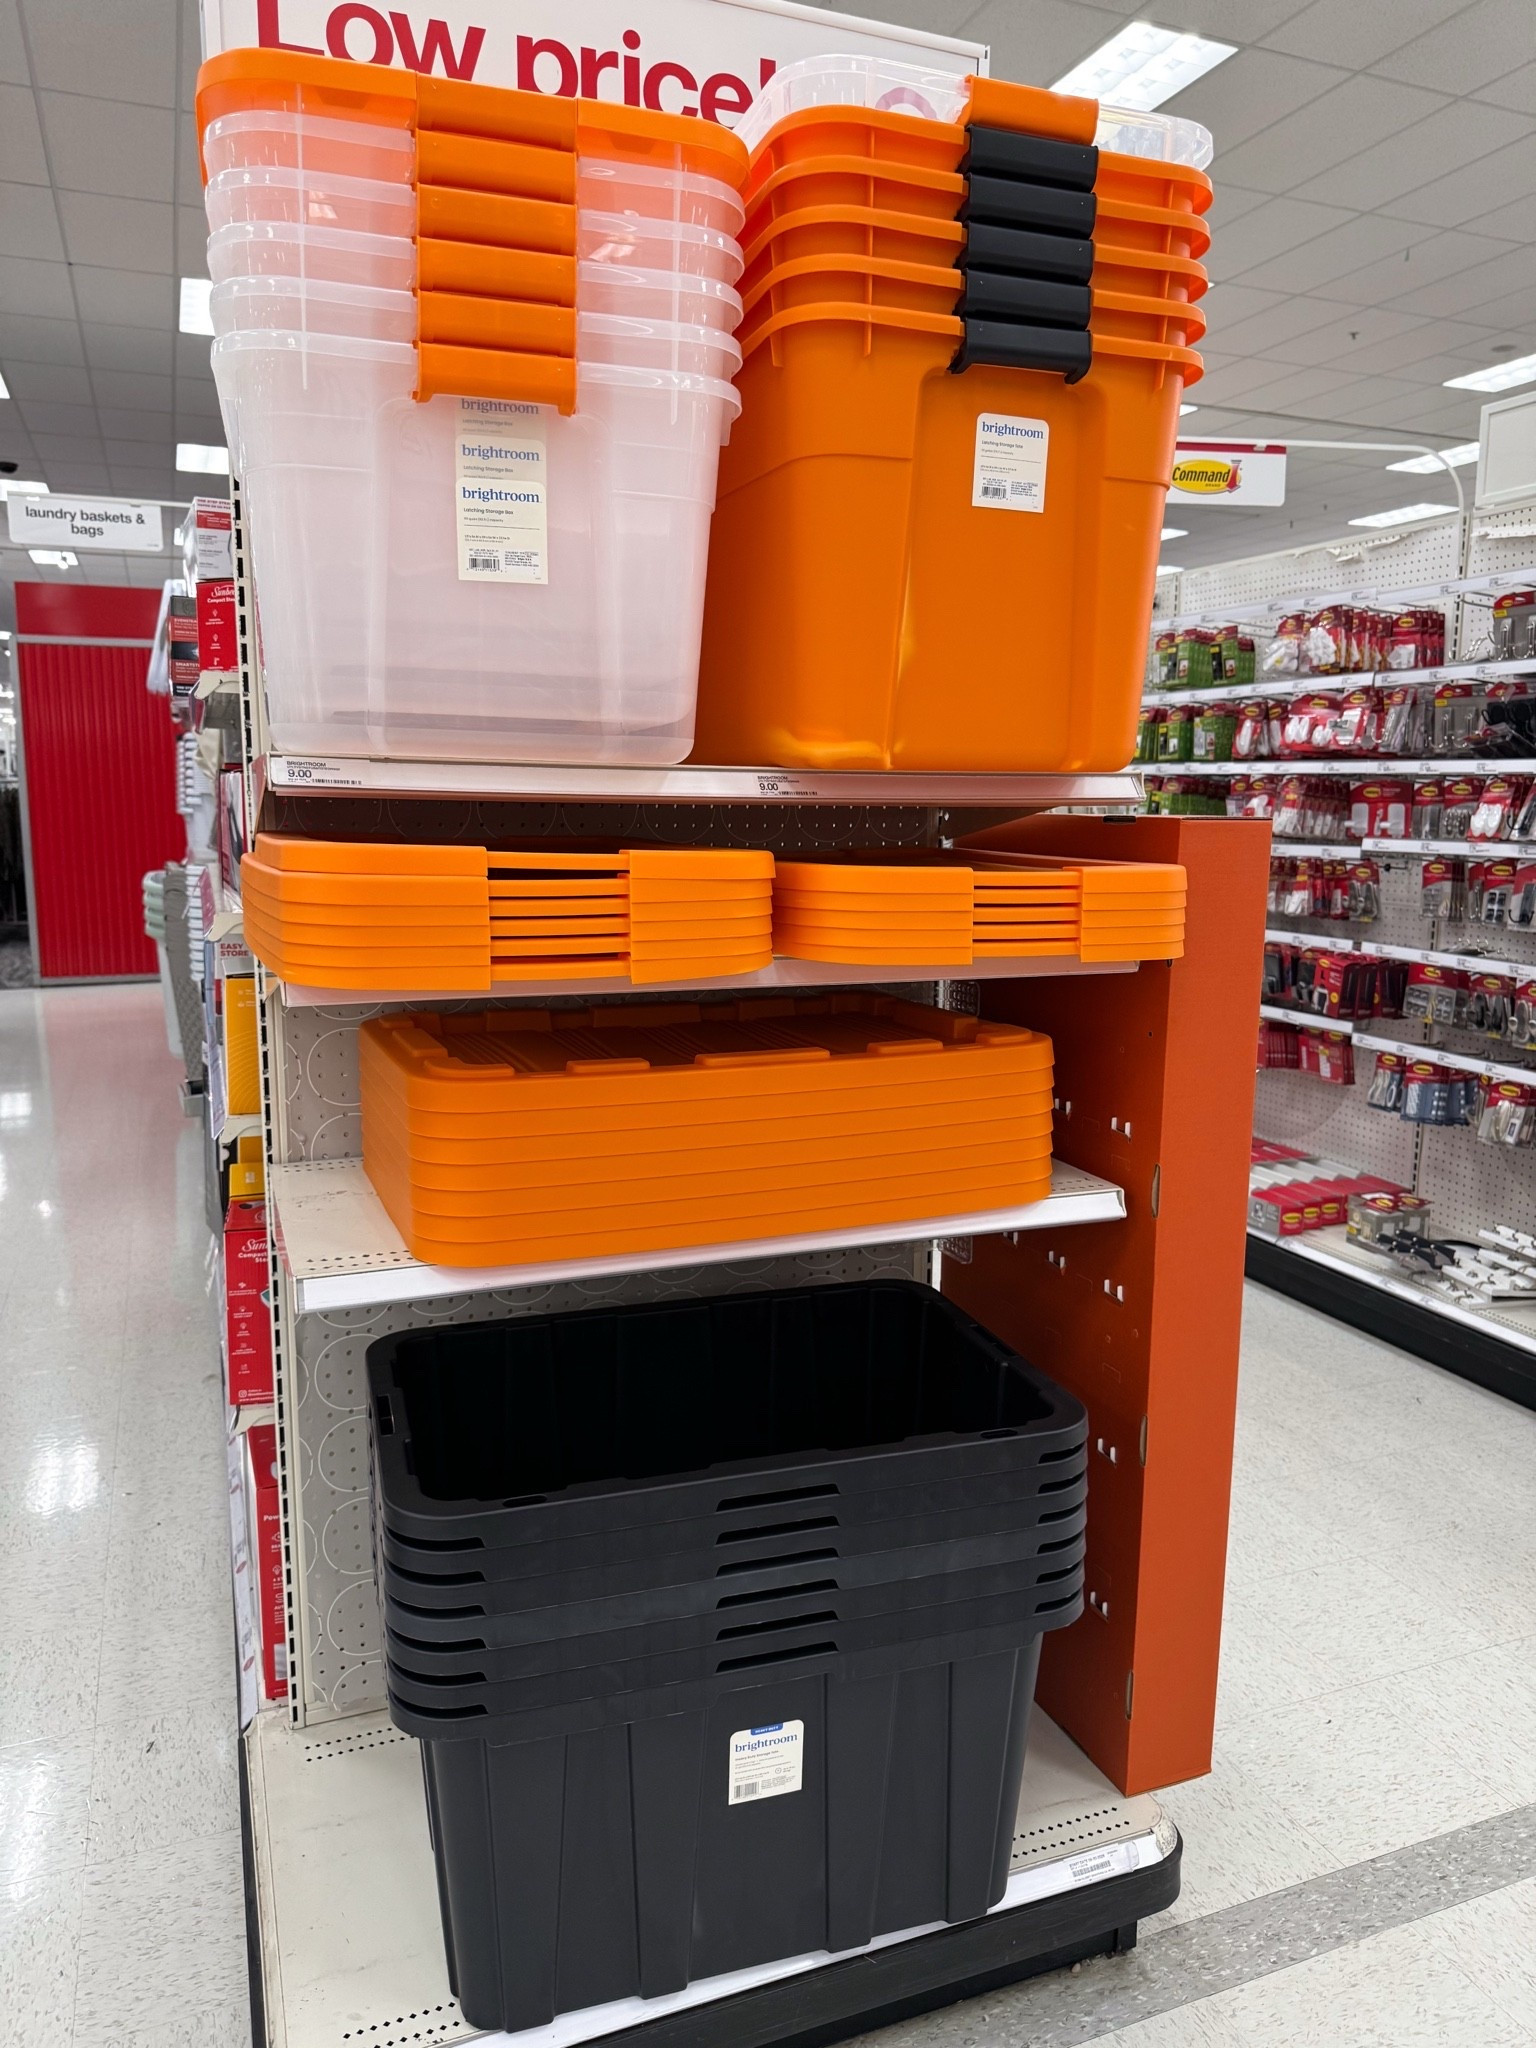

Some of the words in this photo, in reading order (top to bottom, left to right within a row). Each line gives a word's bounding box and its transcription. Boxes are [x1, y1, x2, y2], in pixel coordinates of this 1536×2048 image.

[461, 398, 539, 414] brightroom
[982, 421, 1044, 439] brightroom
[462, 444, 540, 461] brightroom
[1171, 466, 1231, 483] Command
[462, 486, 539, 503] brightroom
[25, 506, 77, 522] laundry
[80, 509, 132, 524] baskets
[136, 513, 145, 524] &
[71, 523, 104, 537] bags
[287, 769, 312, 778] 9.00
[759, 783, 779, 791] 9.00
[241, 1238, 268, 1252] Sun
[735, 1734, 798, 1752] brightroom
